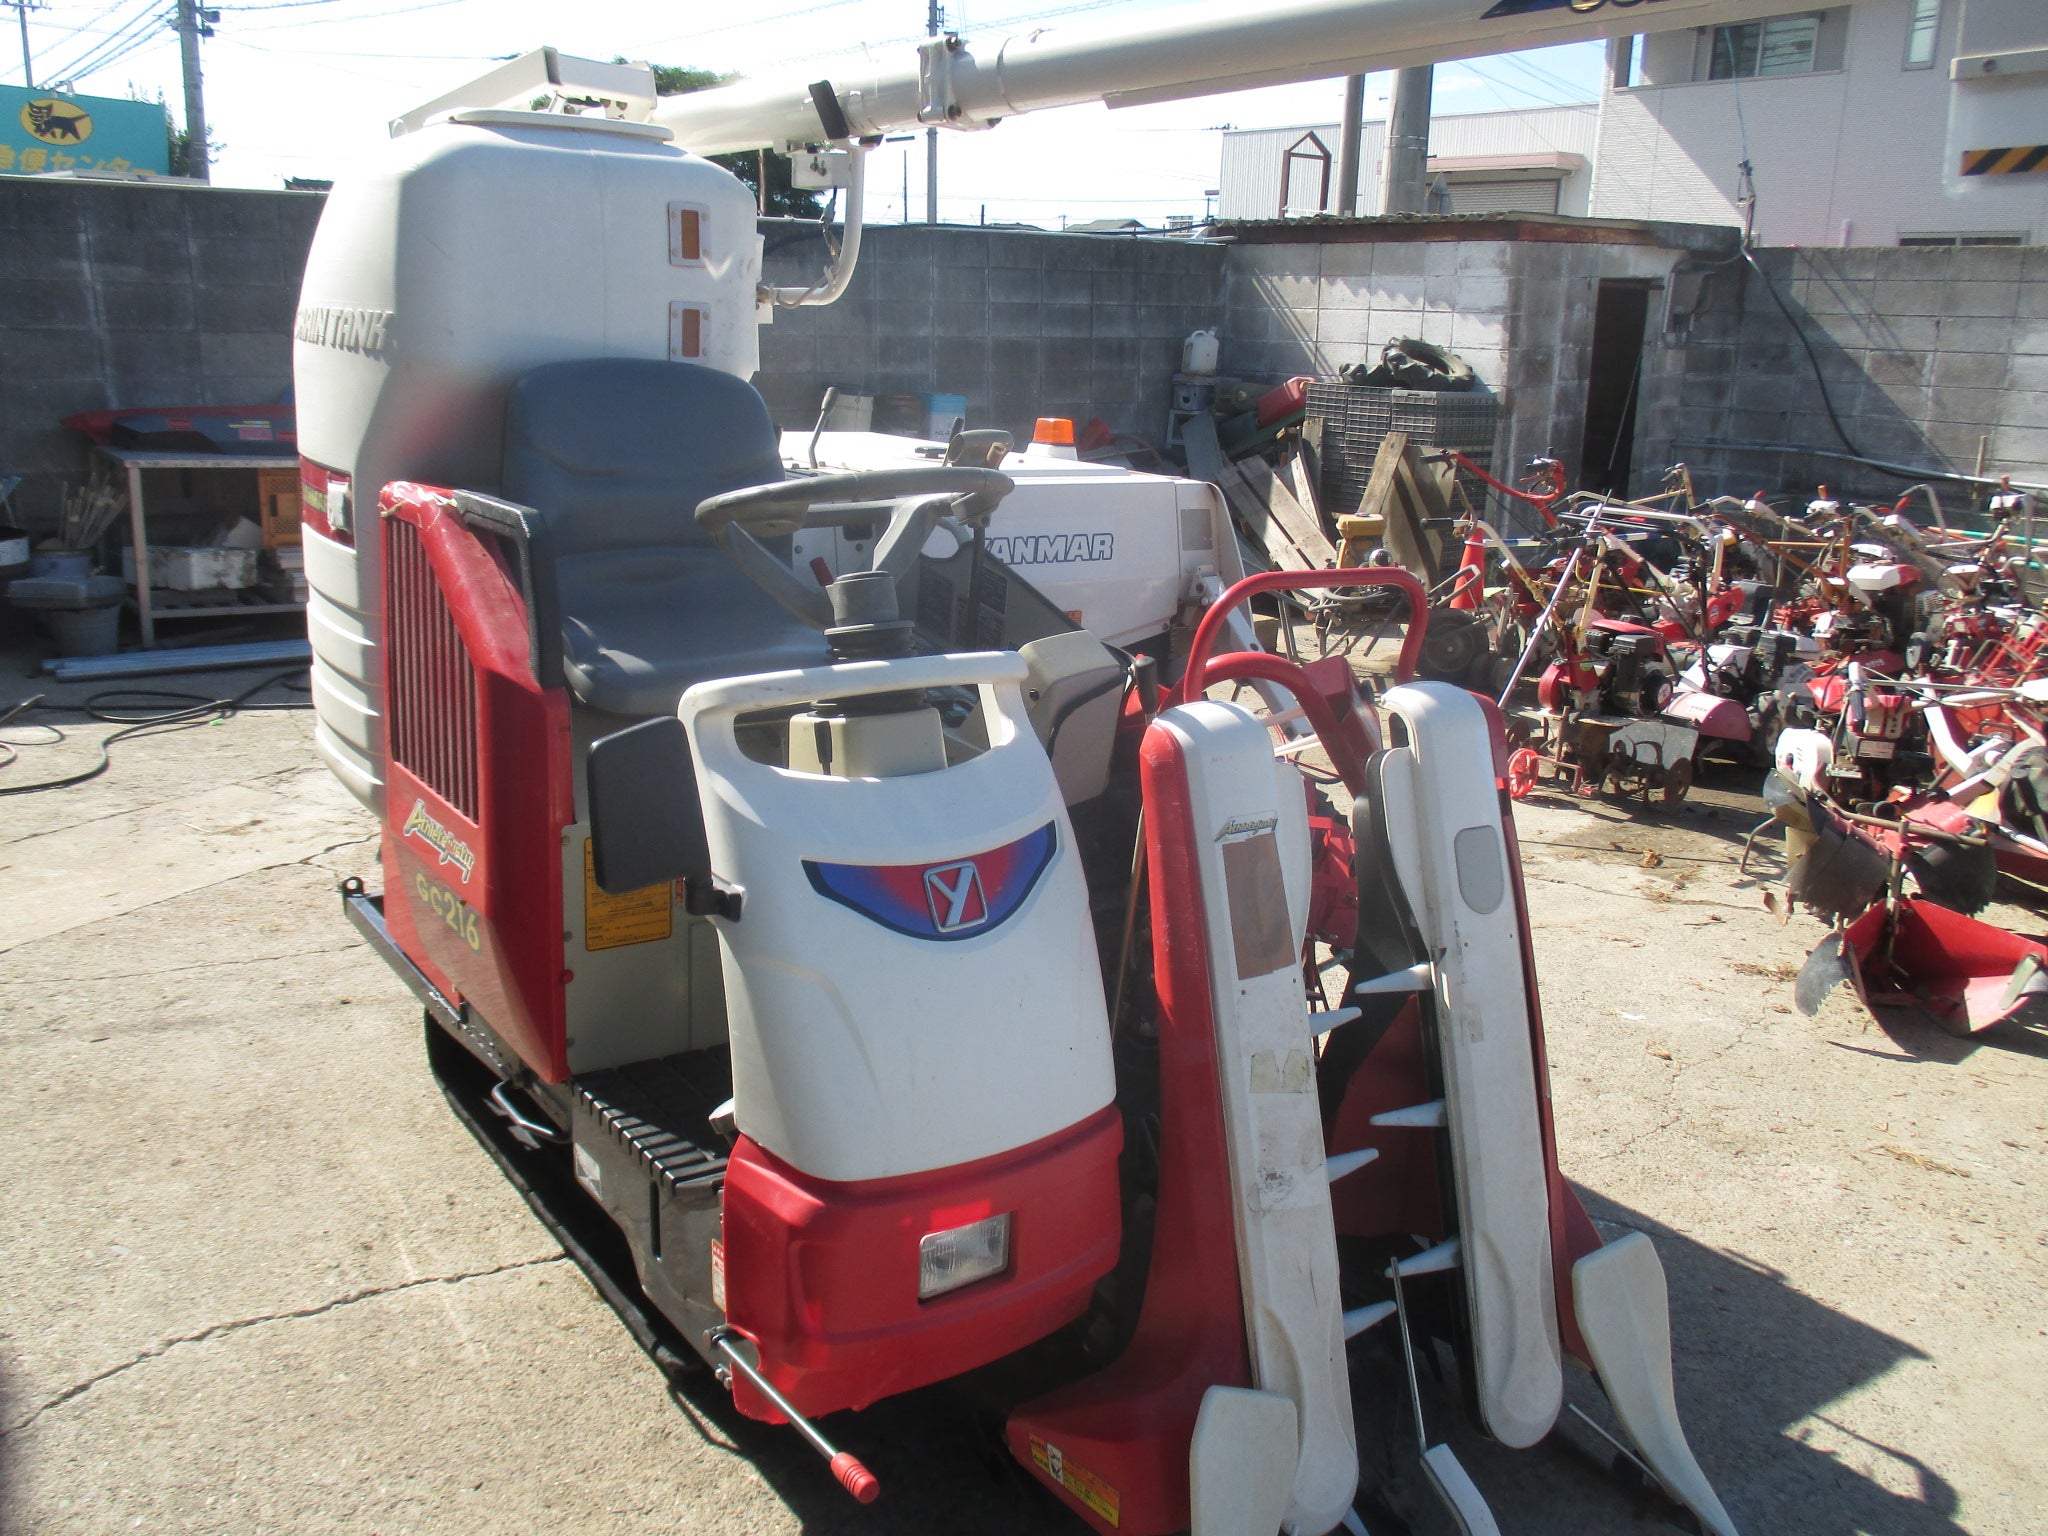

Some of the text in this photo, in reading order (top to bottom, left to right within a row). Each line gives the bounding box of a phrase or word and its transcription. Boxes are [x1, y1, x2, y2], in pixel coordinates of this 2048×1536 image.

[330, 307, 394, 352] TANK
[985, 533, 1114, 565] ANMAR
[415, 872, 480, 951] GC216
